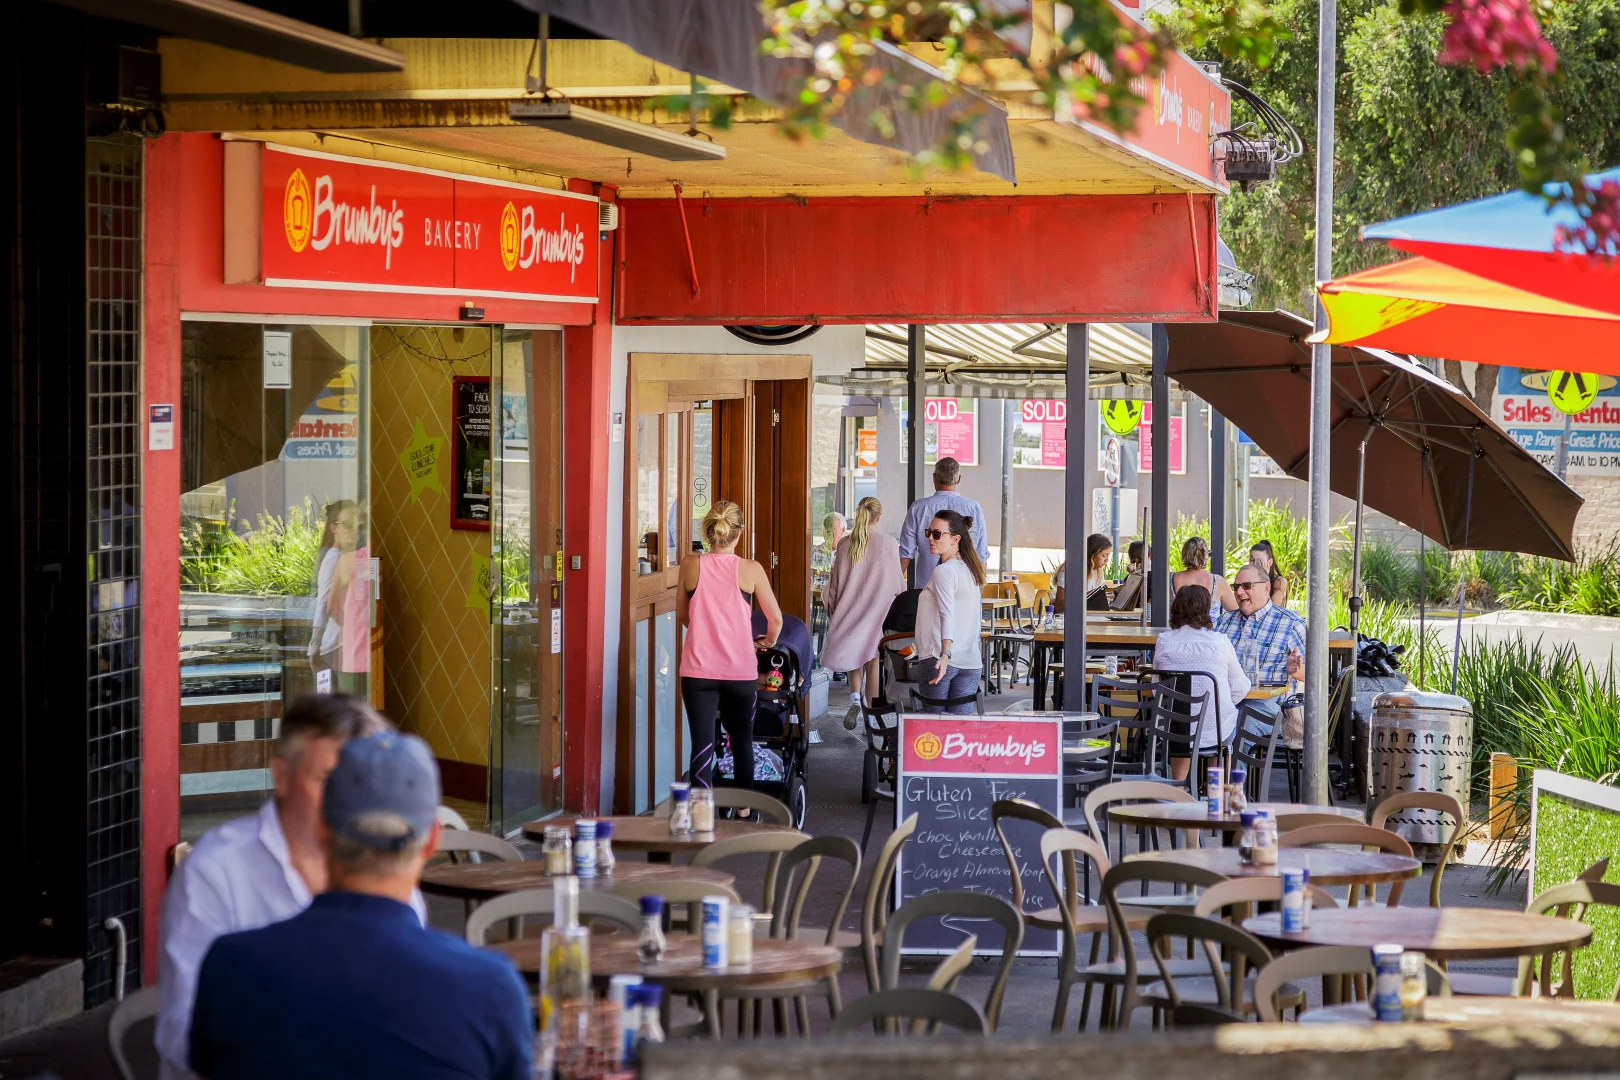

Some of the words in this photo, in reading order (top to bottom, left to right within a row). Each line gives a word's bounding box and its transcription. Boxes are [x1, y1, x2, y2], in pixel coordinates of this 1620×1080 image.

[311, 174, 404, 271] Brumby's
[424, 217, 481, 250] BAKERY
[519, 205, 584, 284] Brumby's
[924, 401, 957, 421] OLD
[1023, 401, 1066, 421] SOLD
[1503, 398, 1552, 423] Sales
[1570, 432, 1596, 449] Great
[410, 453, 436, 472] LUNCHES
[1588, 456, 1597, 467] to
[942, 733, 1046, 766] Brumby's
[905, 777, 972, 802] Gluten
[989, 781, 1027, 802] Free
[917, 830, 954, 844] Choc
